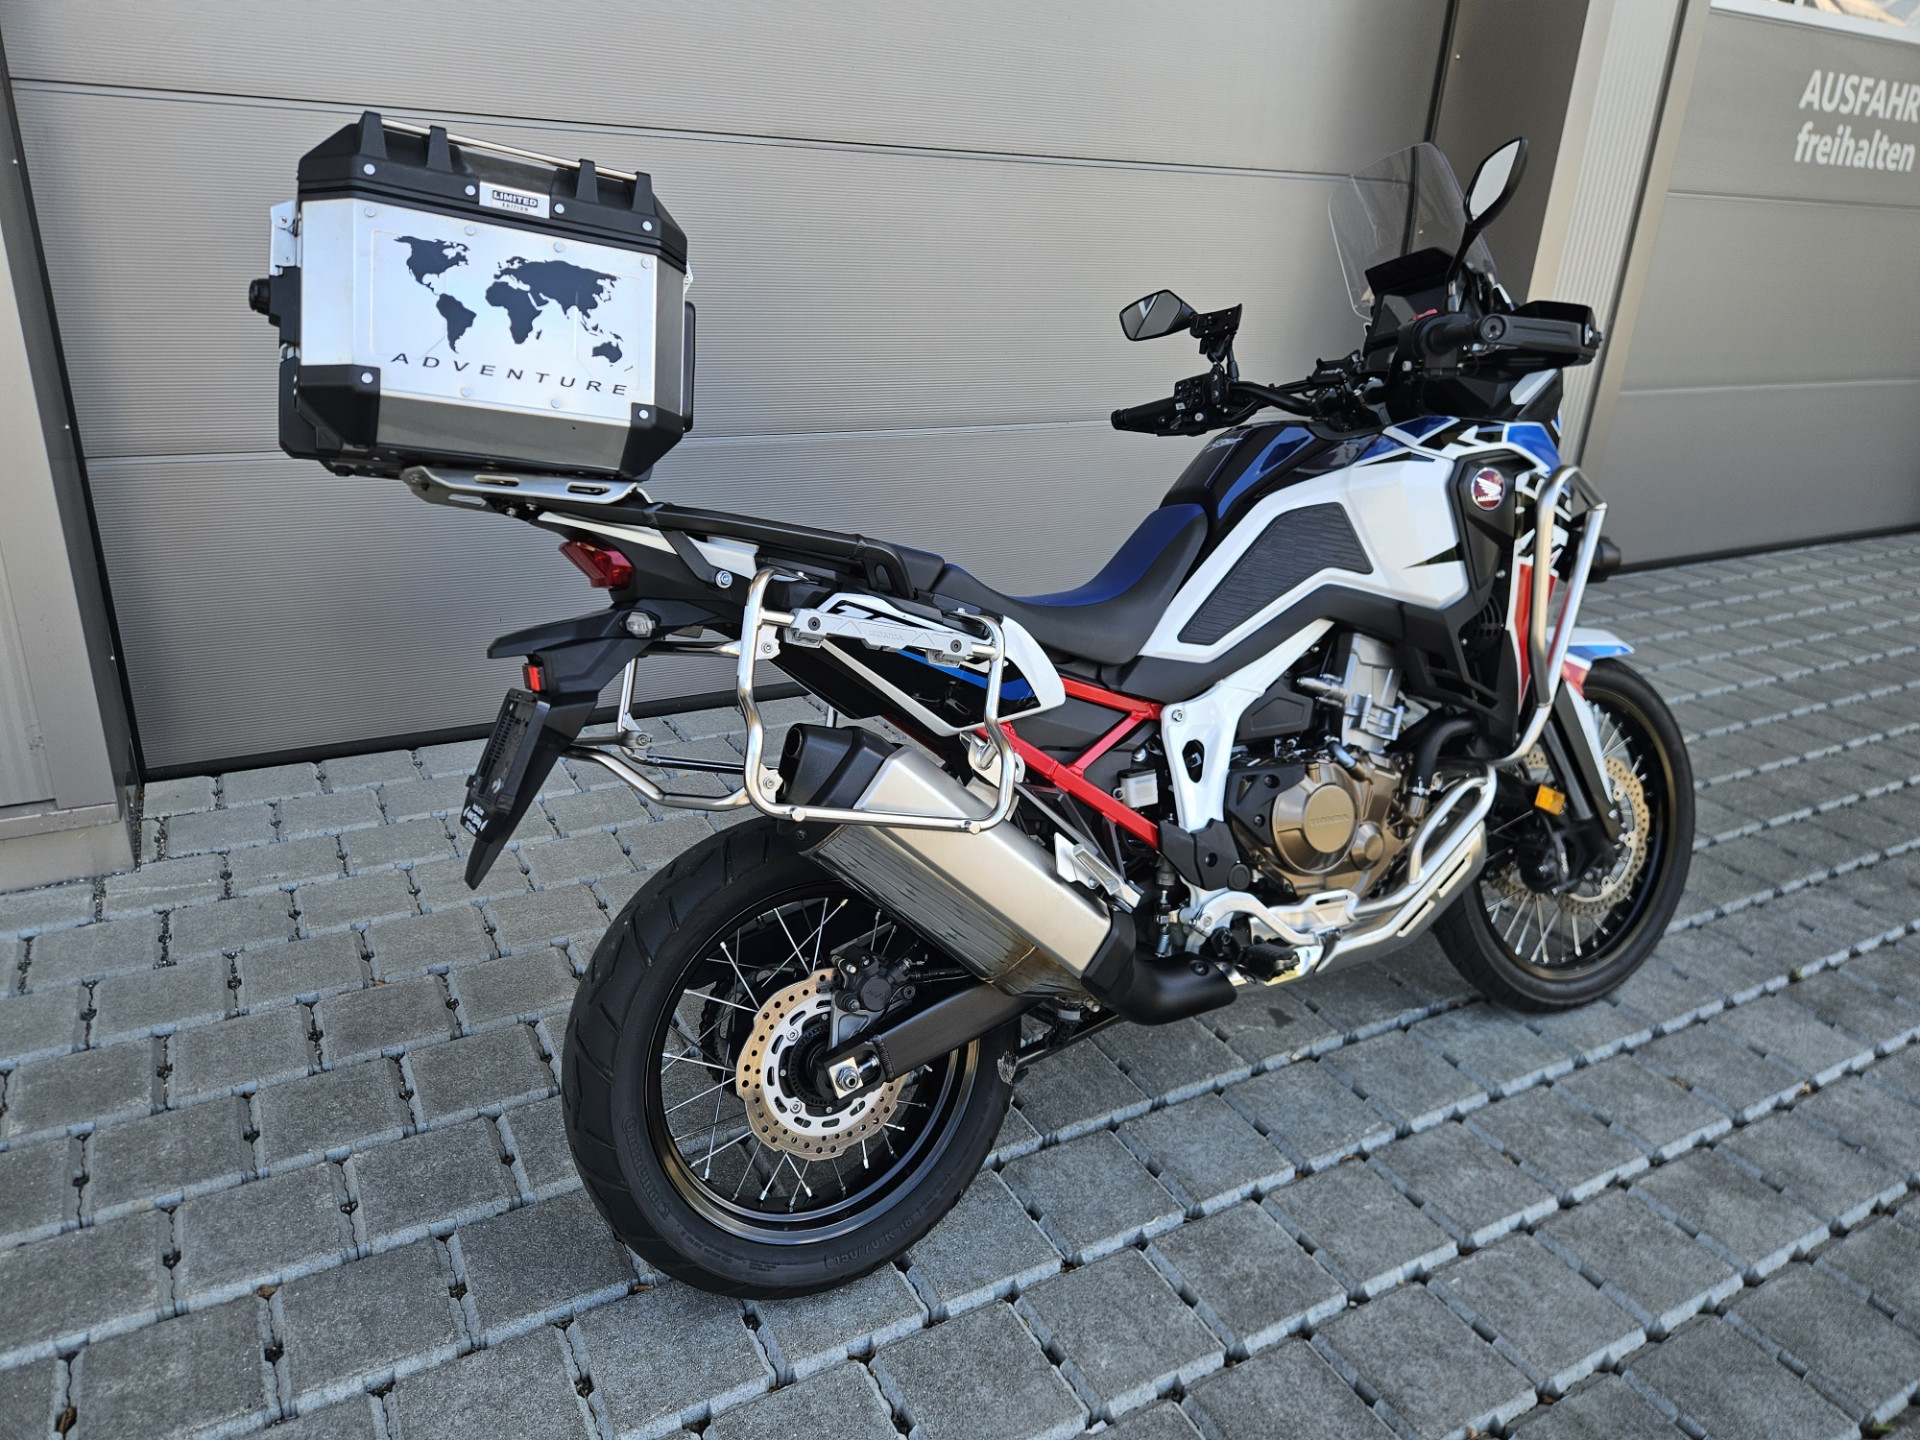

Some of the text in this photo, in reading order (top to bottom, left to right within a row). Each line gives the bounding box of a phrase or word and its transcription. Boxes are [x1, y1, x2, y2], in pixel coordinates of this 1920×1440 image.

[1798, 69, 1920, 123] AUSFAHR
[1794, 121, 1916, 172] freihalten
[493, 190, 538, 207] LIMITED
[391, 353, 627, 396] ADVENTURE
[1310, 813, 1350, 826] HONDA
